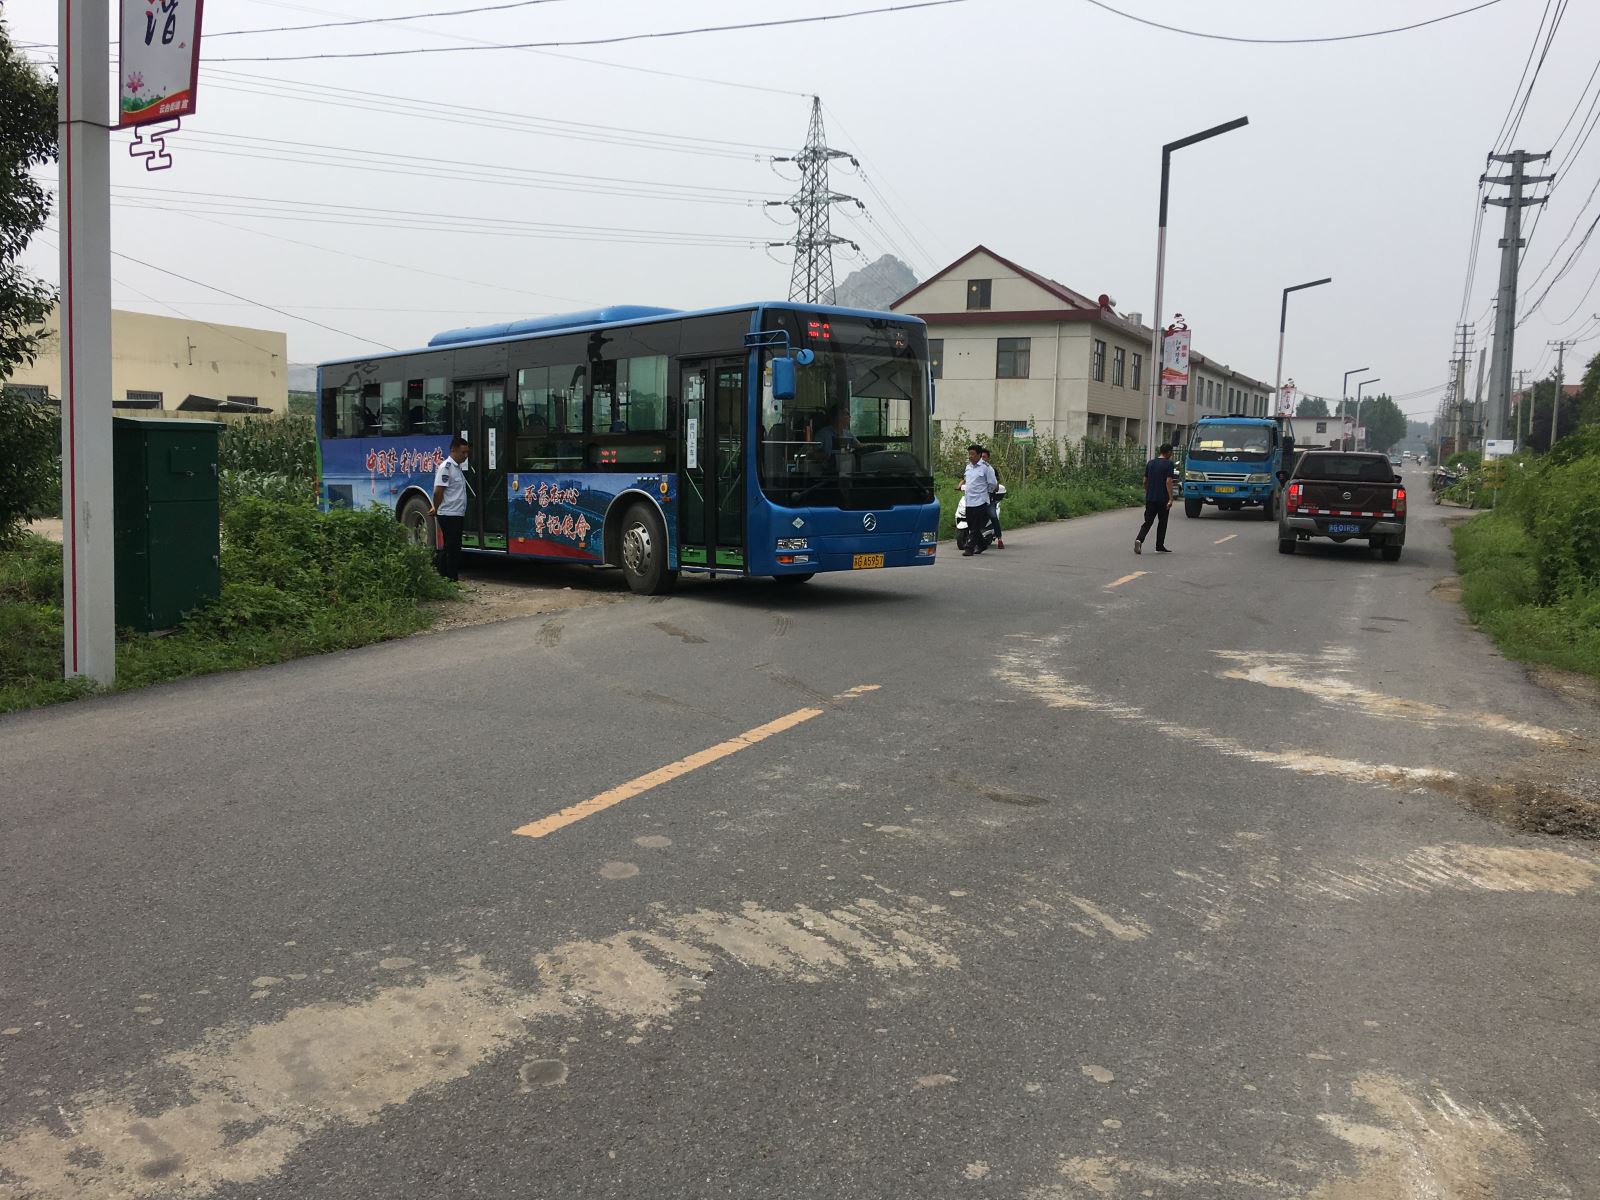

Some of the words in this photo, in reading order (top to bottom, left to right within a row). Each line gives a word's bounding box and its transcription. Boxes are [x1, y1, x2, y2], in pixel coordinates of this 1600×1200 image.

[524, 482, 580, 508] 不忘初心
[535, 511, 591, 541] 牢记使命
